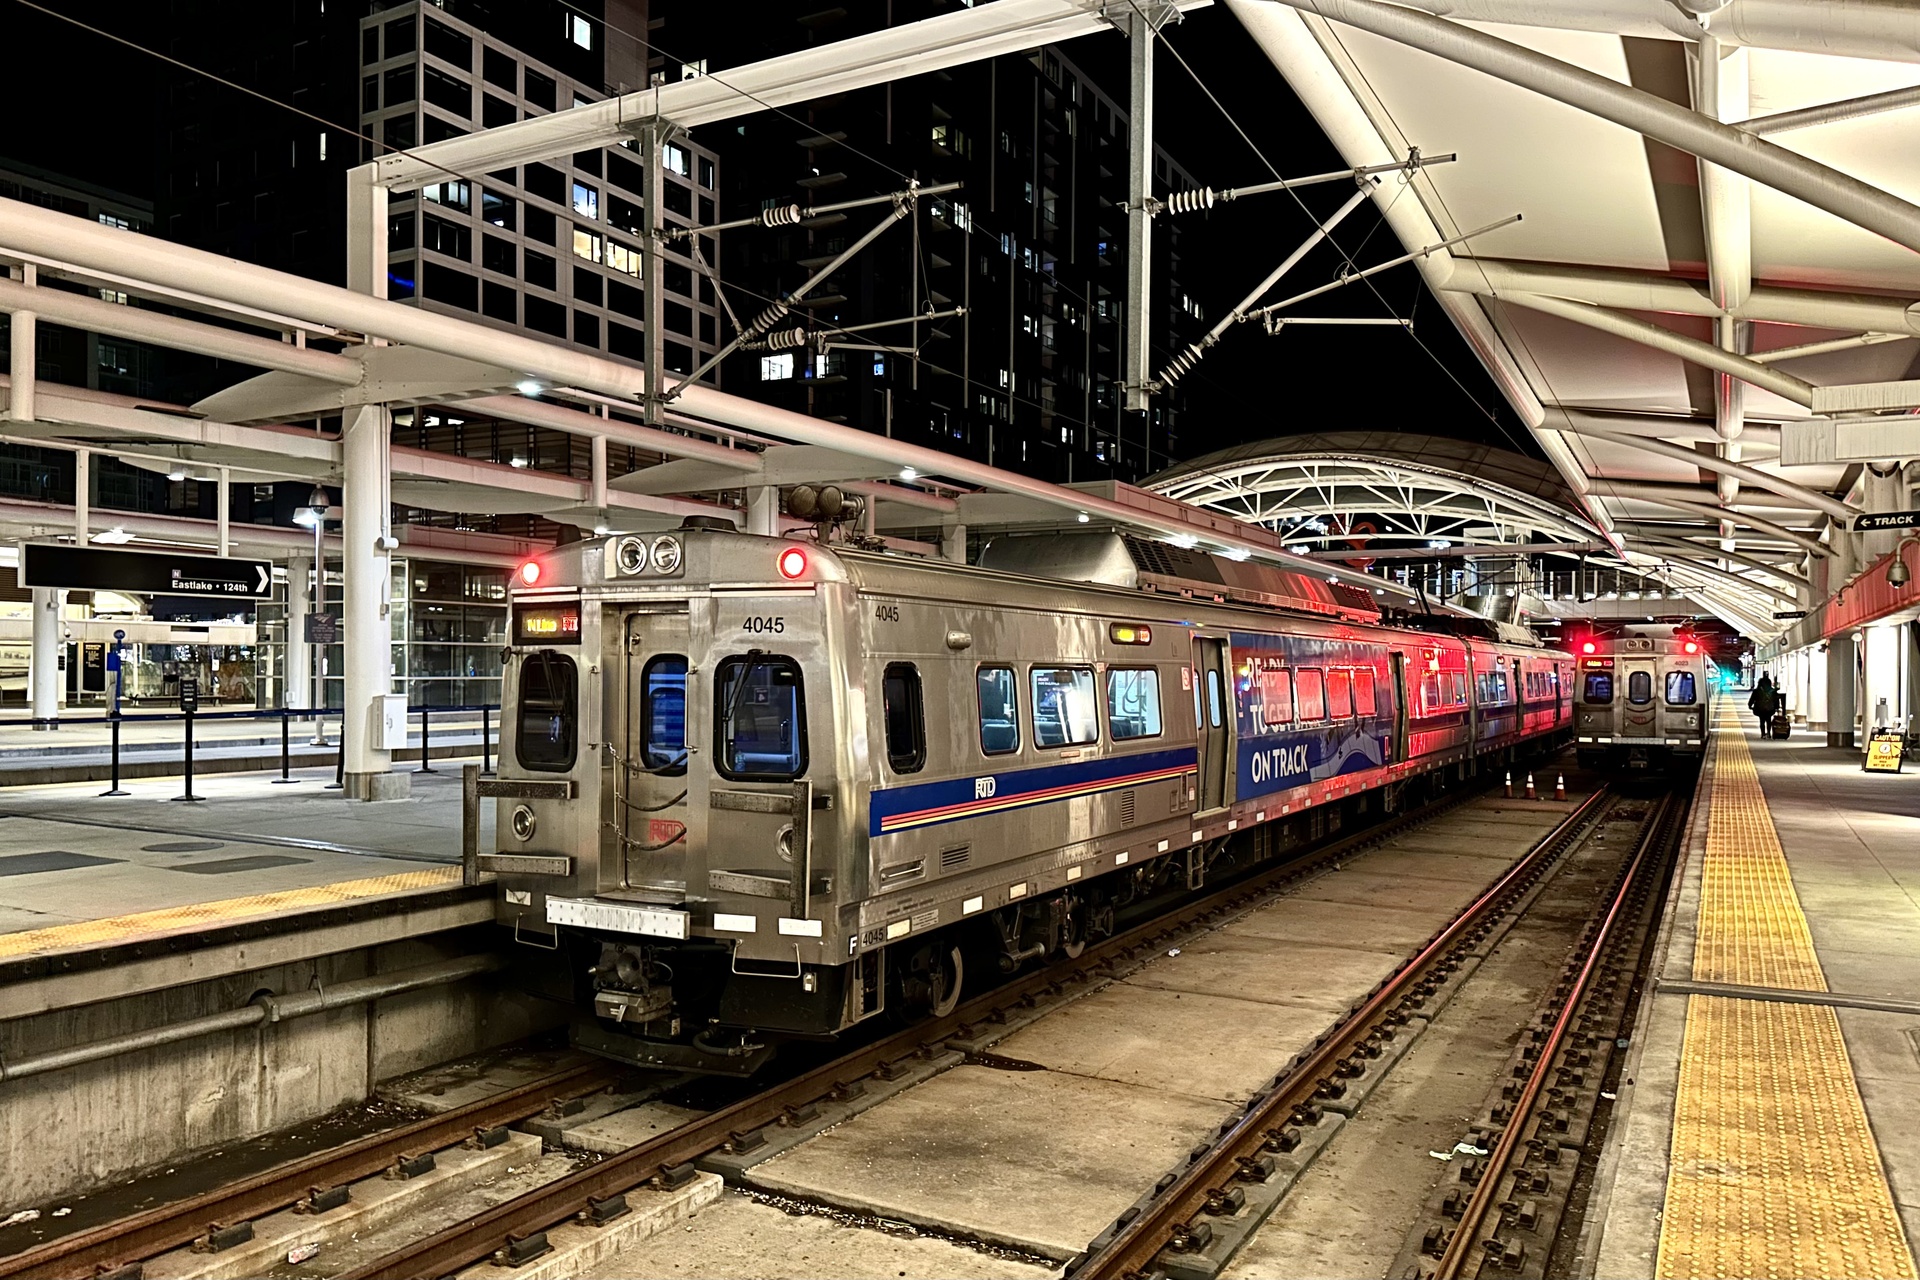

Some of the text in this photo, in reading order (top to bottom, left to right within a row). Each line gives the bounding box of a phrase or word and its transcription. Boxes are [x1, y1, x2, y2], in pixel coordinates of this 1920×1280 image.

[1874, 515, 1914, 526] TRACK
[172, 579, 248, 592] Eastlake 124th
[875, 605, 899, 622] 4045
[742, 616, 785, 633] 4045
[1251, 744, 1308, 784] ON TRACK
[975, 776, 996, 800] RTD
[649, 819, 686, 843] RTD
[849, 928, 884, 955] F 4045
